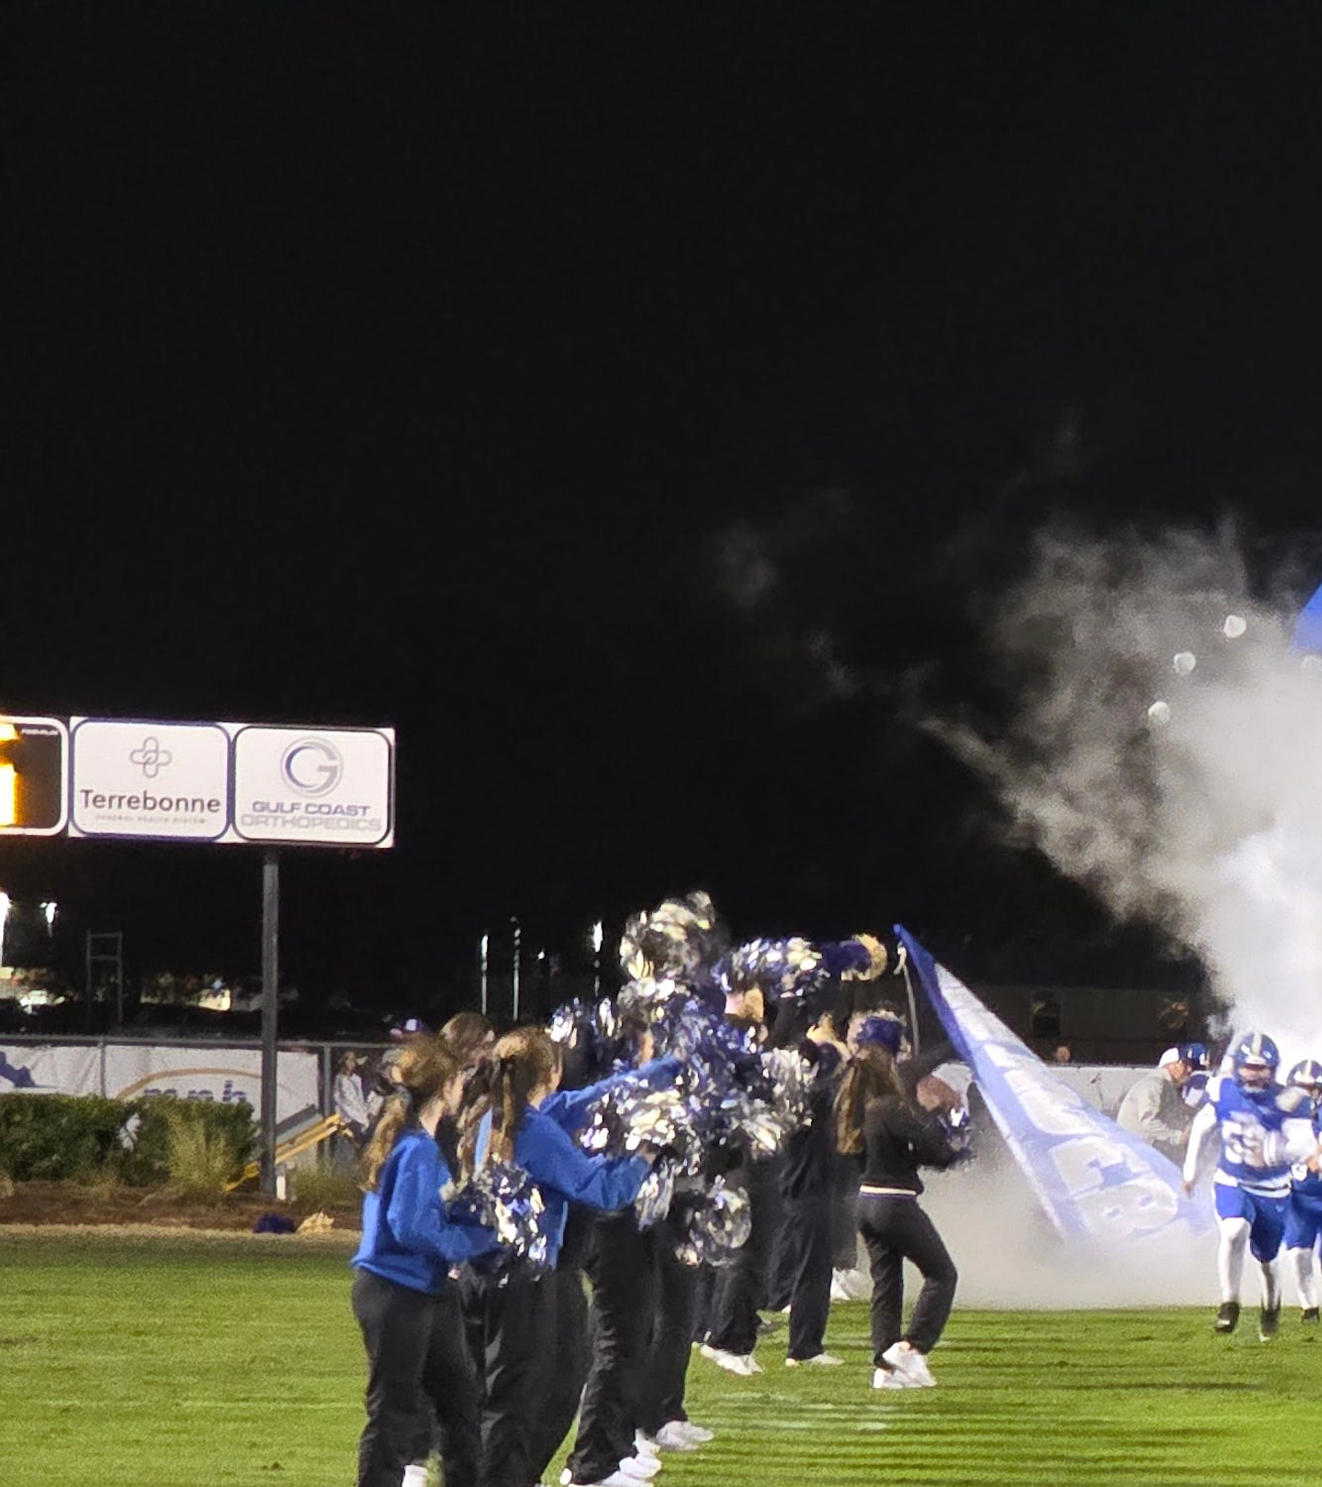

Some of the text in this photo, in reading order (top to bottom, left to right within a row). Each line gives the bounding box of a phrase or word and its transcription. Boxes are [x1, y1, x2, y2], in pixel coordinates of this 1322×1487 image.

[79, 788, 222, 814] Terrebonne
[252, 800, 371, 817] GULF COAST
[240, 813, 383, 832] ORTHOPEDICS
